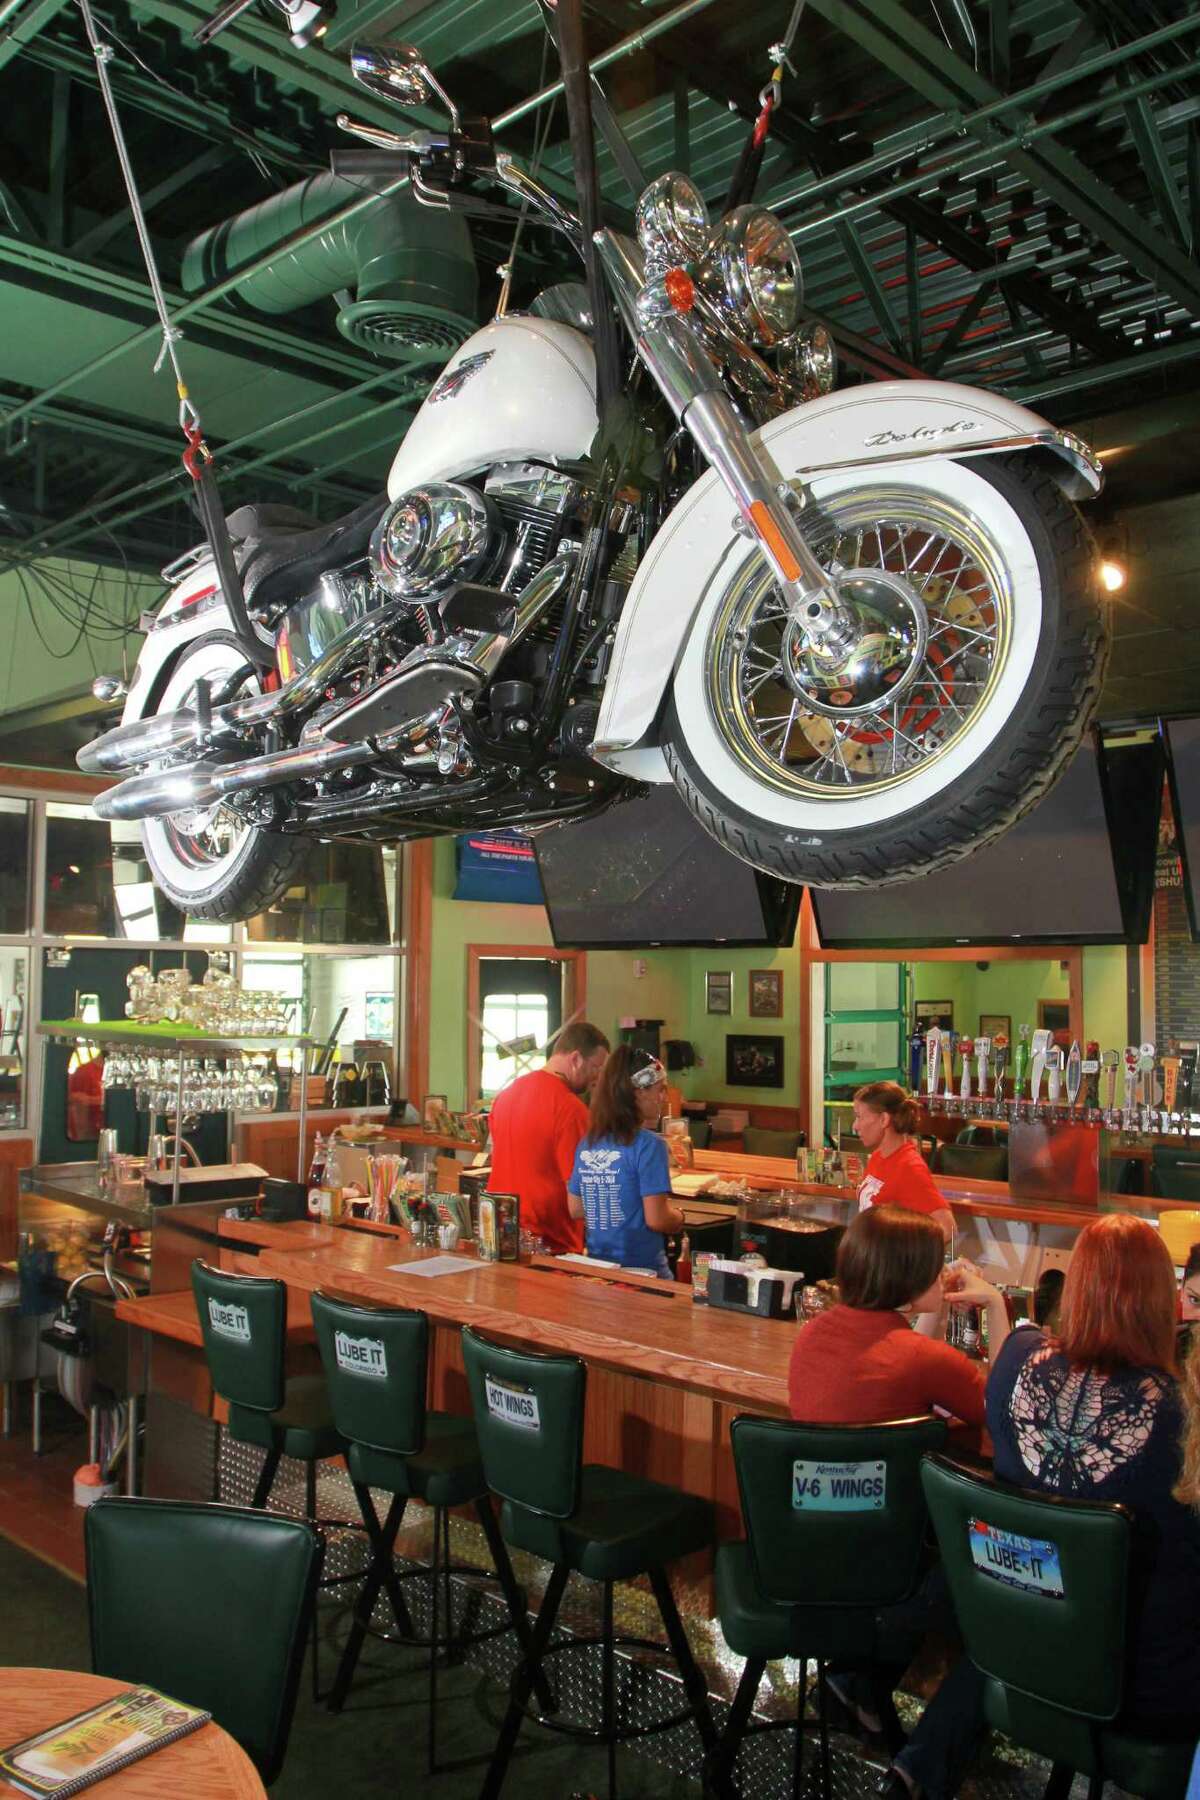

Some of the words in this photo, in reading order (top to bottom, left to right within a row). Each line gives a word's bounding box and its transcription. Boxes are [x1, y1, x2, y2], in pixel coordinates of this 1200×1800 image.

[212, 1308, 235, 1328] LUBE
[338, 1340, 369, 1363] LUBE
[370, 1349, 382, 1365] IT
[490, 1386, 504, 1408] HOT
[504, 1393, 534, 1418] WINGS
[831, 1477, 884, 1499] WINGS
[988, 1525, 1032, 1552] TEXAS
